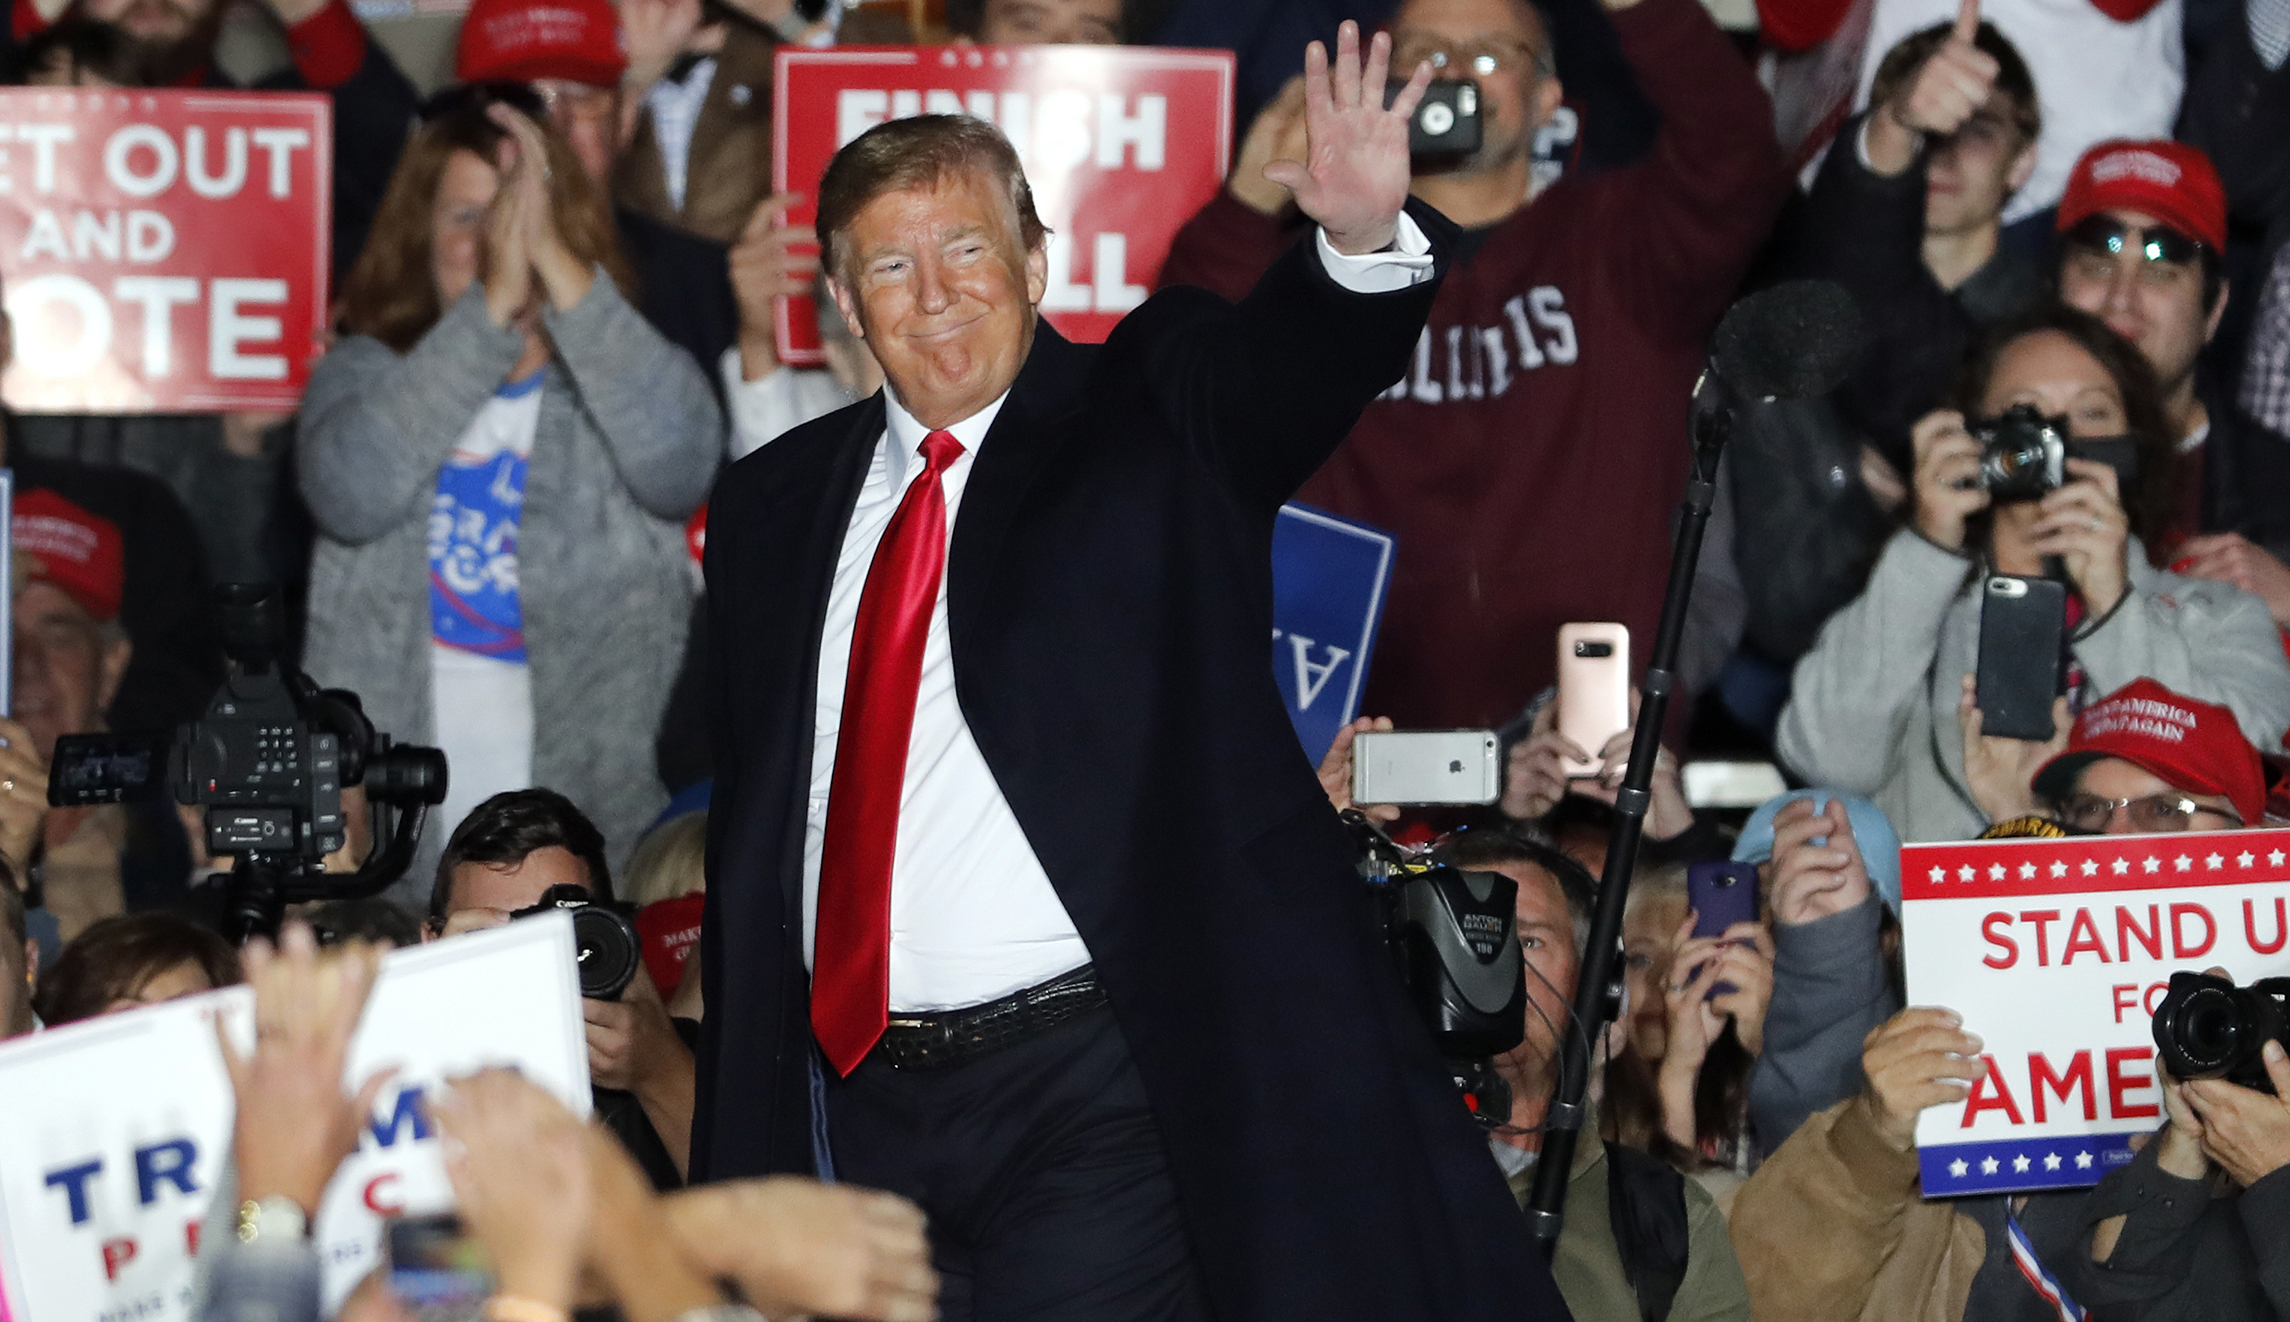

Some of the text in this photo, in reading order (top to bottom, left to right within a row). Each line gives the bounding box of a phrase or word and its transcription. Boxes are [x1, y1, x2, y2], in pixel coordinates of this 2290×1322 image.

[0, 124, 310, 199] T OUT
[20, 208, 176, 263] AND
[2120, 698, 2197, 729] AMERICA
[2127, 717, 2186, 742] AGAIN
[555, 899, 589, 908] Canon
[1981, 896, 2288, 970] STAND U
